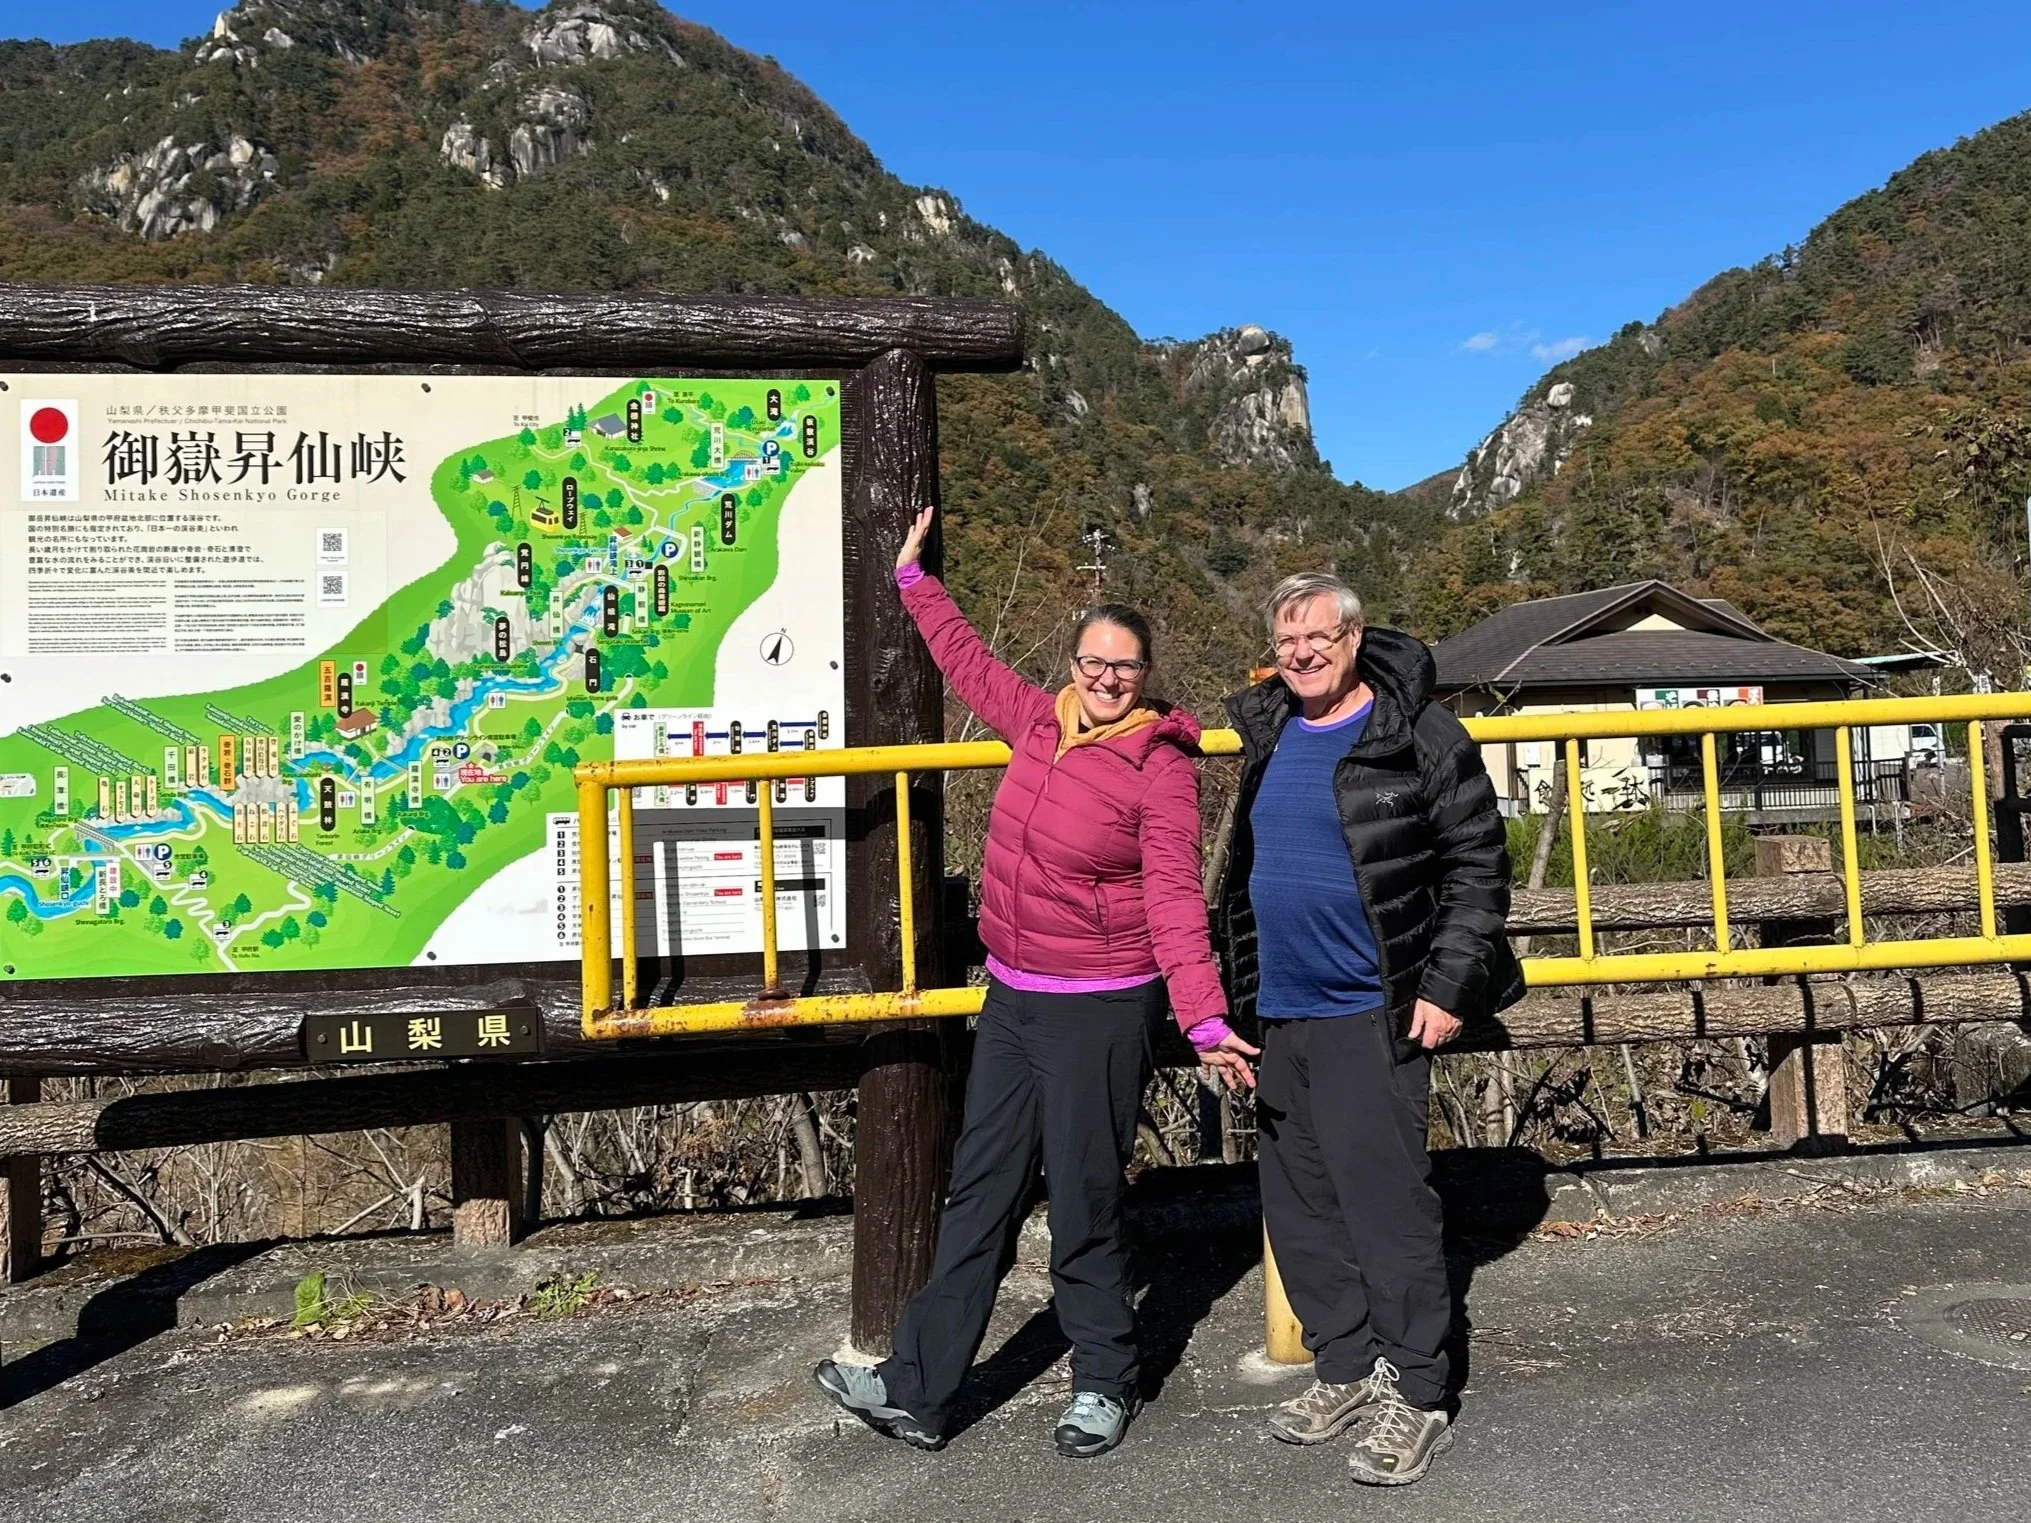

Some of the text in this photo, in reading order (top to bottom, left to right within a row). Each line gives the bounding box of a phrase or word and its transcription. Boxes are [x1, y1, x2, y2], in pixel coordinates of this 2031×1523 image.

[769, 394, 779, 416] 大滝
[101, 430, 407, 485] 御嶽昇仙峡
[766, 443, 777, 455] P
[33, 489, 66, 497] 日本遺産
[104, 488, 342, 502] Mitake Shosenkyo Gorge
[566, 484, 574, 522] ロープウェイ
[724, 501, 733, 538] 荒川ダム
[665, 544, 676, 557] P
[588, 656, 597, 687] 石門
[458, 745, 468, 758] P
[158, 846, 169, 858] P
[340, 1014, 511, 1054] 山梨県
